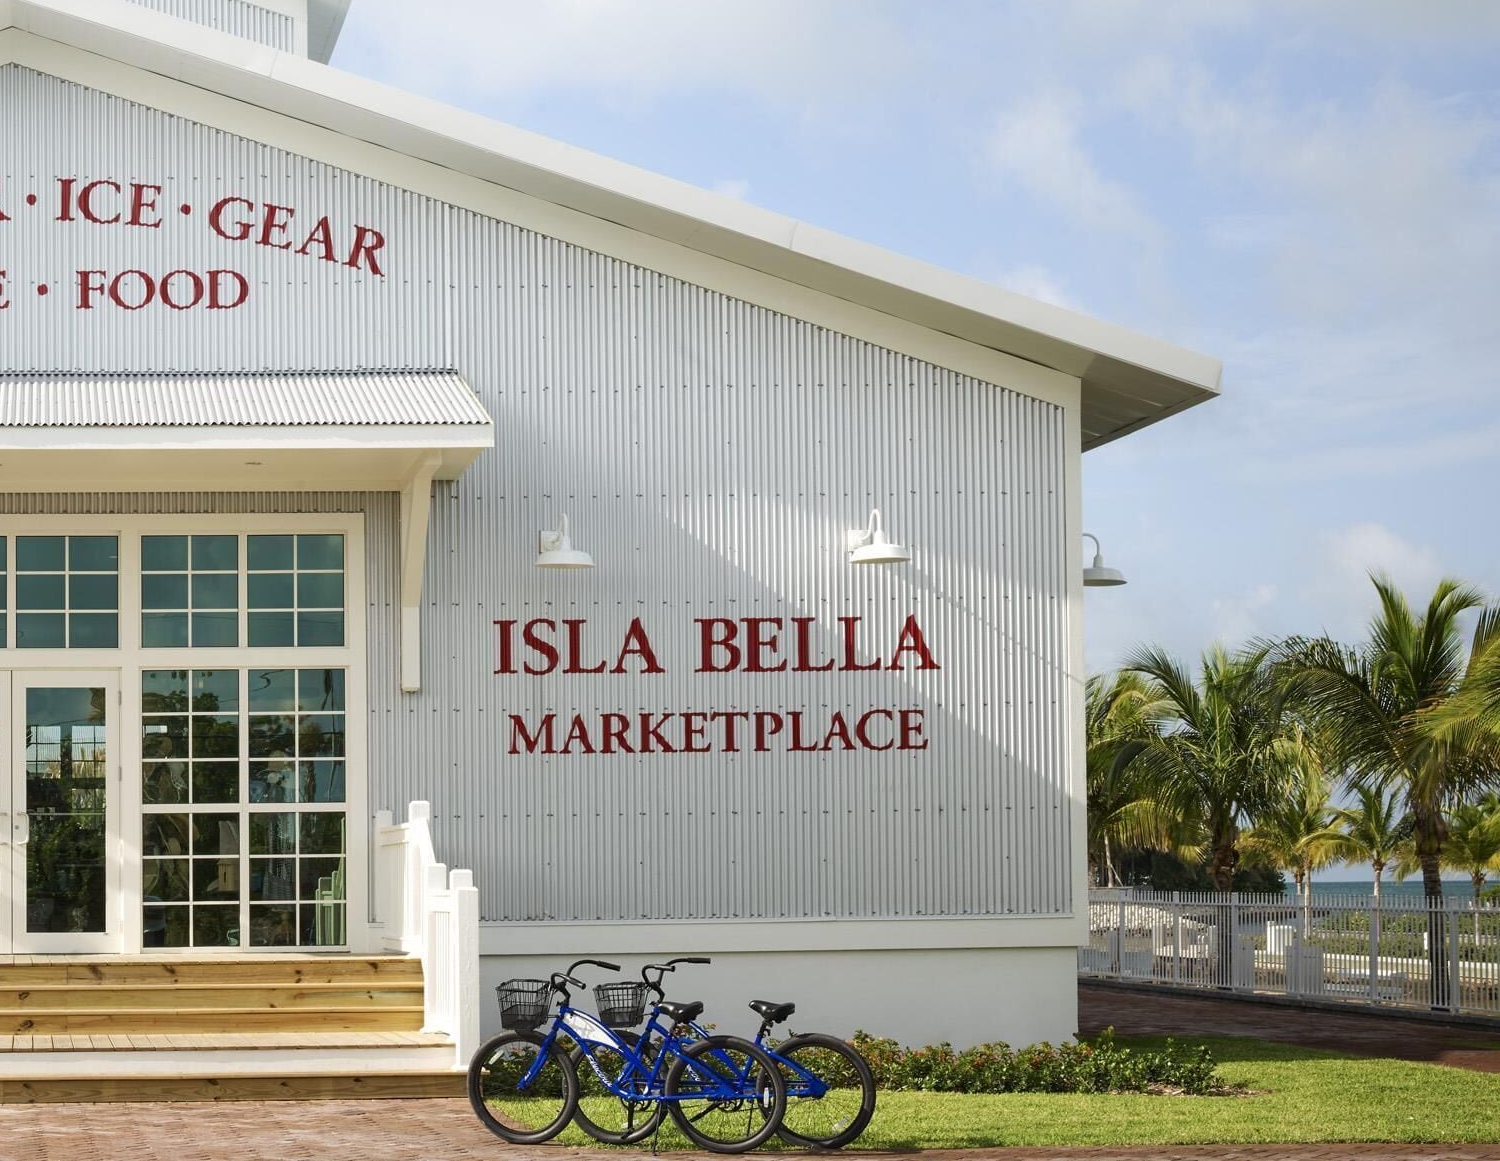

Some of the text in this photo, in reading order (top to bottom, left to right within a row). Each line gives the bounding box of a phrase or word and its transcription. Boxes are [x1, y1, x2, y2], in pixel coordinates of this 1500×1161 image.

[55, 177, 163, 229] ICE
[207, 196, 386, 277] GEAR
[75, 269, 249, 311] FOOD
[493, 613, 942, 676] ISLA BELLA
[507, 708, 929, 755] MARKETPLACE
